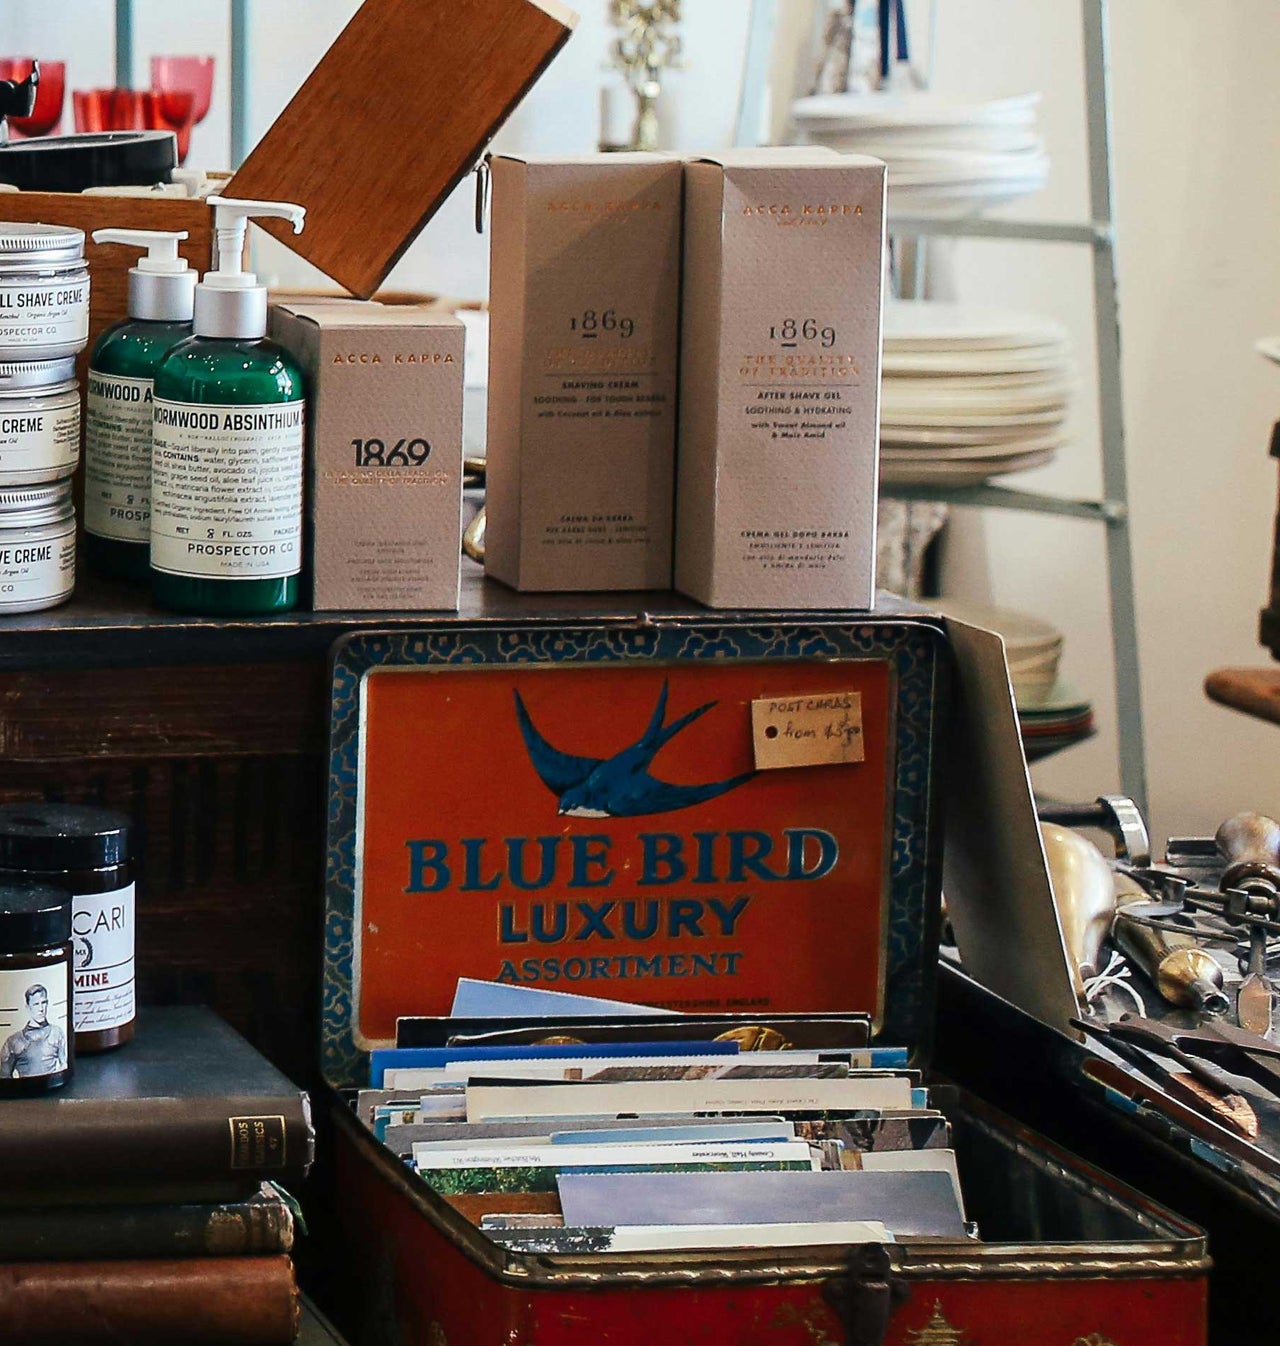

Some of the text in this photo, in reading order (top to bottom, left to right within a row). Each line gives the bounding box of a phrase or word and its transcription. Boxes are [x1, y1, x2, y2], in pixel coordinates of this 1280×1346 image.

[743, 205, 864, 215] ACCA KAPPA
[17, 291, 54, 307] SHAVE
[57, 289, 83, 305] CREME
[570, 309, 634, 338] 1869
[770, 318, 836, 347] 1869
[334, 353, 454, 364] ACCA KAPPA
[824, 391, 841, 399] GEL
[2, 417, 43, 432] CREME
[223, 411, 299, 431] ABSINTHIUM
[351, 438, 431, 466] 1869
[15, 545, 52, 563] CREME
[188, 543, 275, 556] PROSPECTOR
[403, 828, 840, 895] BLUE BIRD
[497, 896, 751, 945] LUXURY
[498, 952, 743, 982] ASSORTMENT
